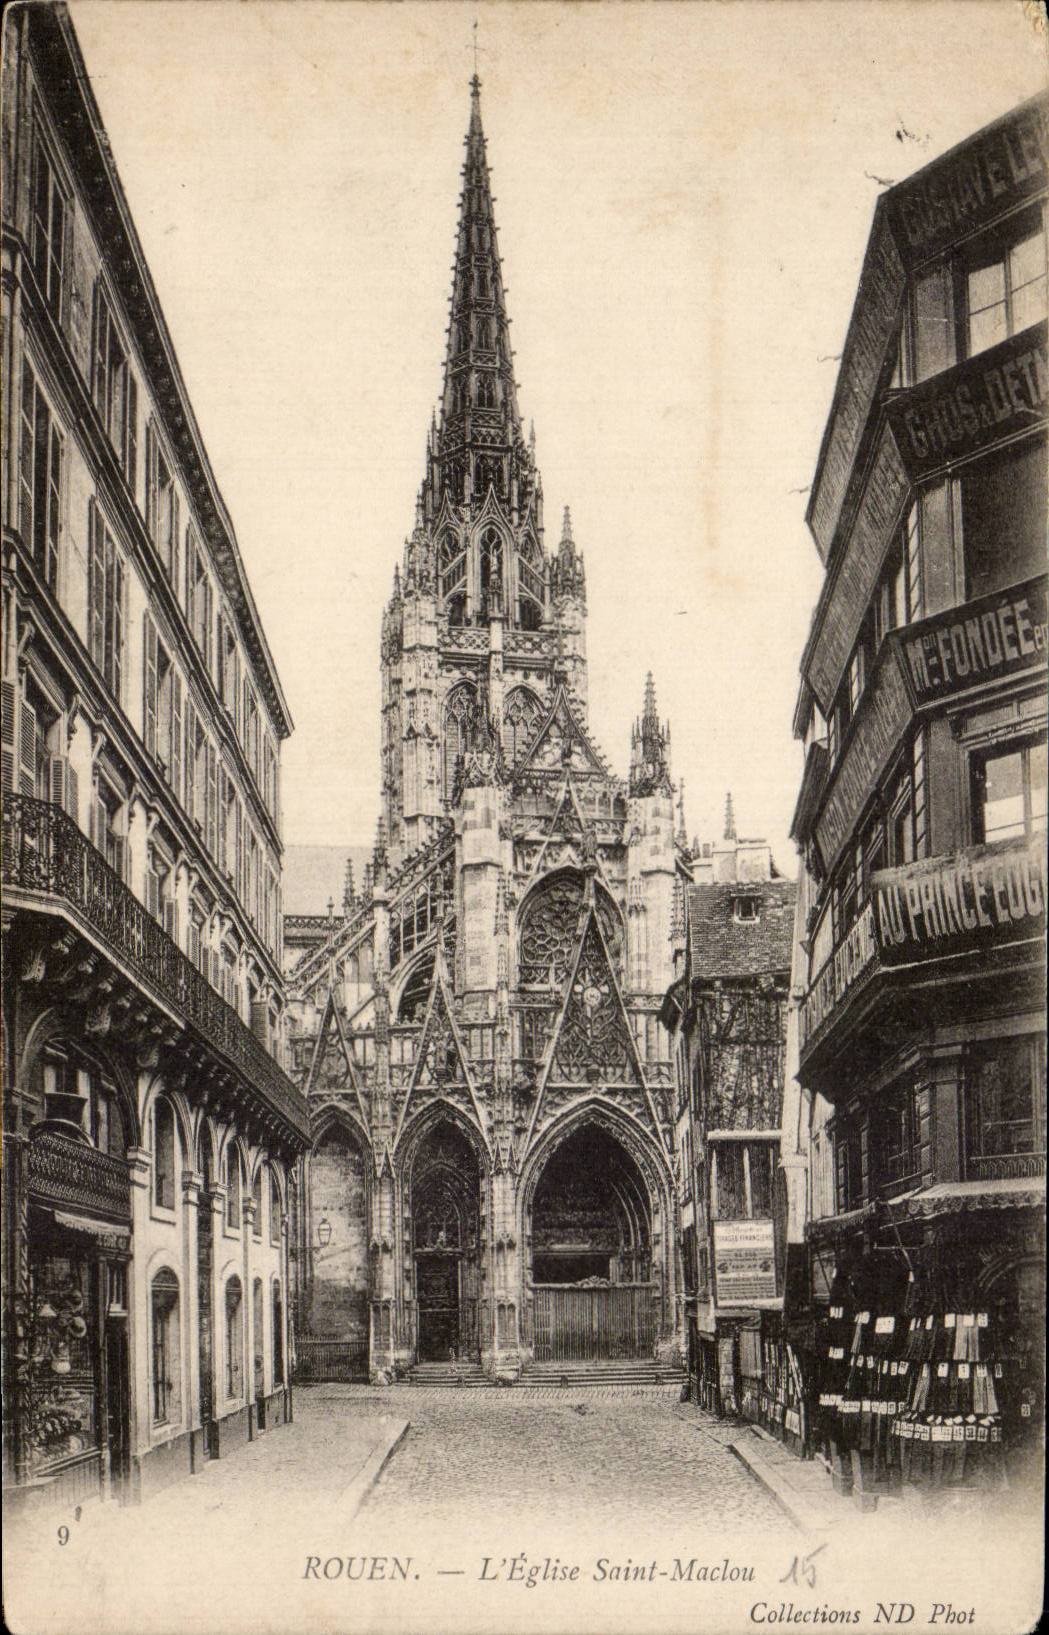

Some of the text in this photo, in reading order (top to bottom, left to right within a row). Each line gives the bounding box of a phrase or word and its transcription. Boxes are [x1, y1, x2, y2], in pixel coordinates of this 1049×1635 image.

[936, 598, 1036, 683] FONDÉE
[878, 884, 907, 947] AU
[904, 862, 994, 943] PRINCE
